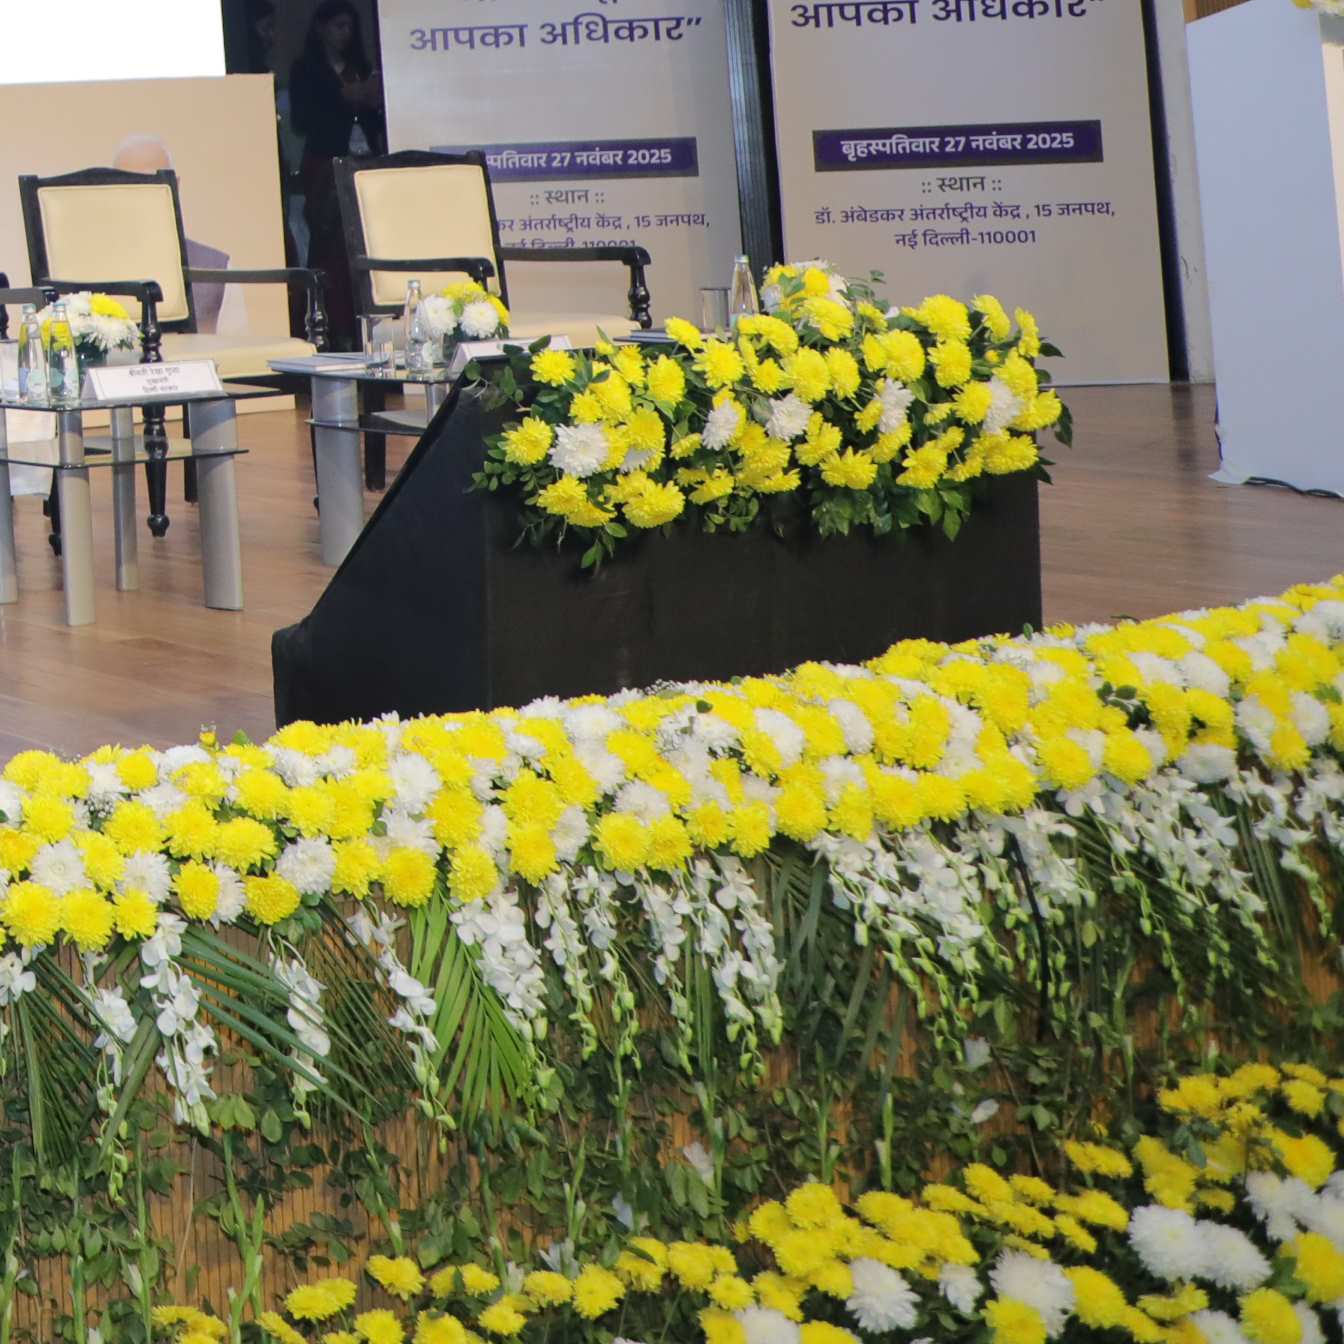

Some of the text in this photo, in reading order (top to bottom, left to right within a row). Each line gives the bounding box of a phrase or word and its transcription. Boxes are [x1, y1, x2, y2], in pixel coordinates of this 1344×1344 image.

[790, 0, 919, 29] आपका
[410, 12, 701, 51] आपका अधिकार”
[840, 132, 1074, 161] बृहस्पतिवार 27 नवंबर 2025
[551, 148, 671, 167] 27 नवंबर 2025
[937, 176, 986, 192] स्थान
[544, 189, 589, 205] स्थान
[894, 228, 1037, 249] नई दिल्ली-110001
